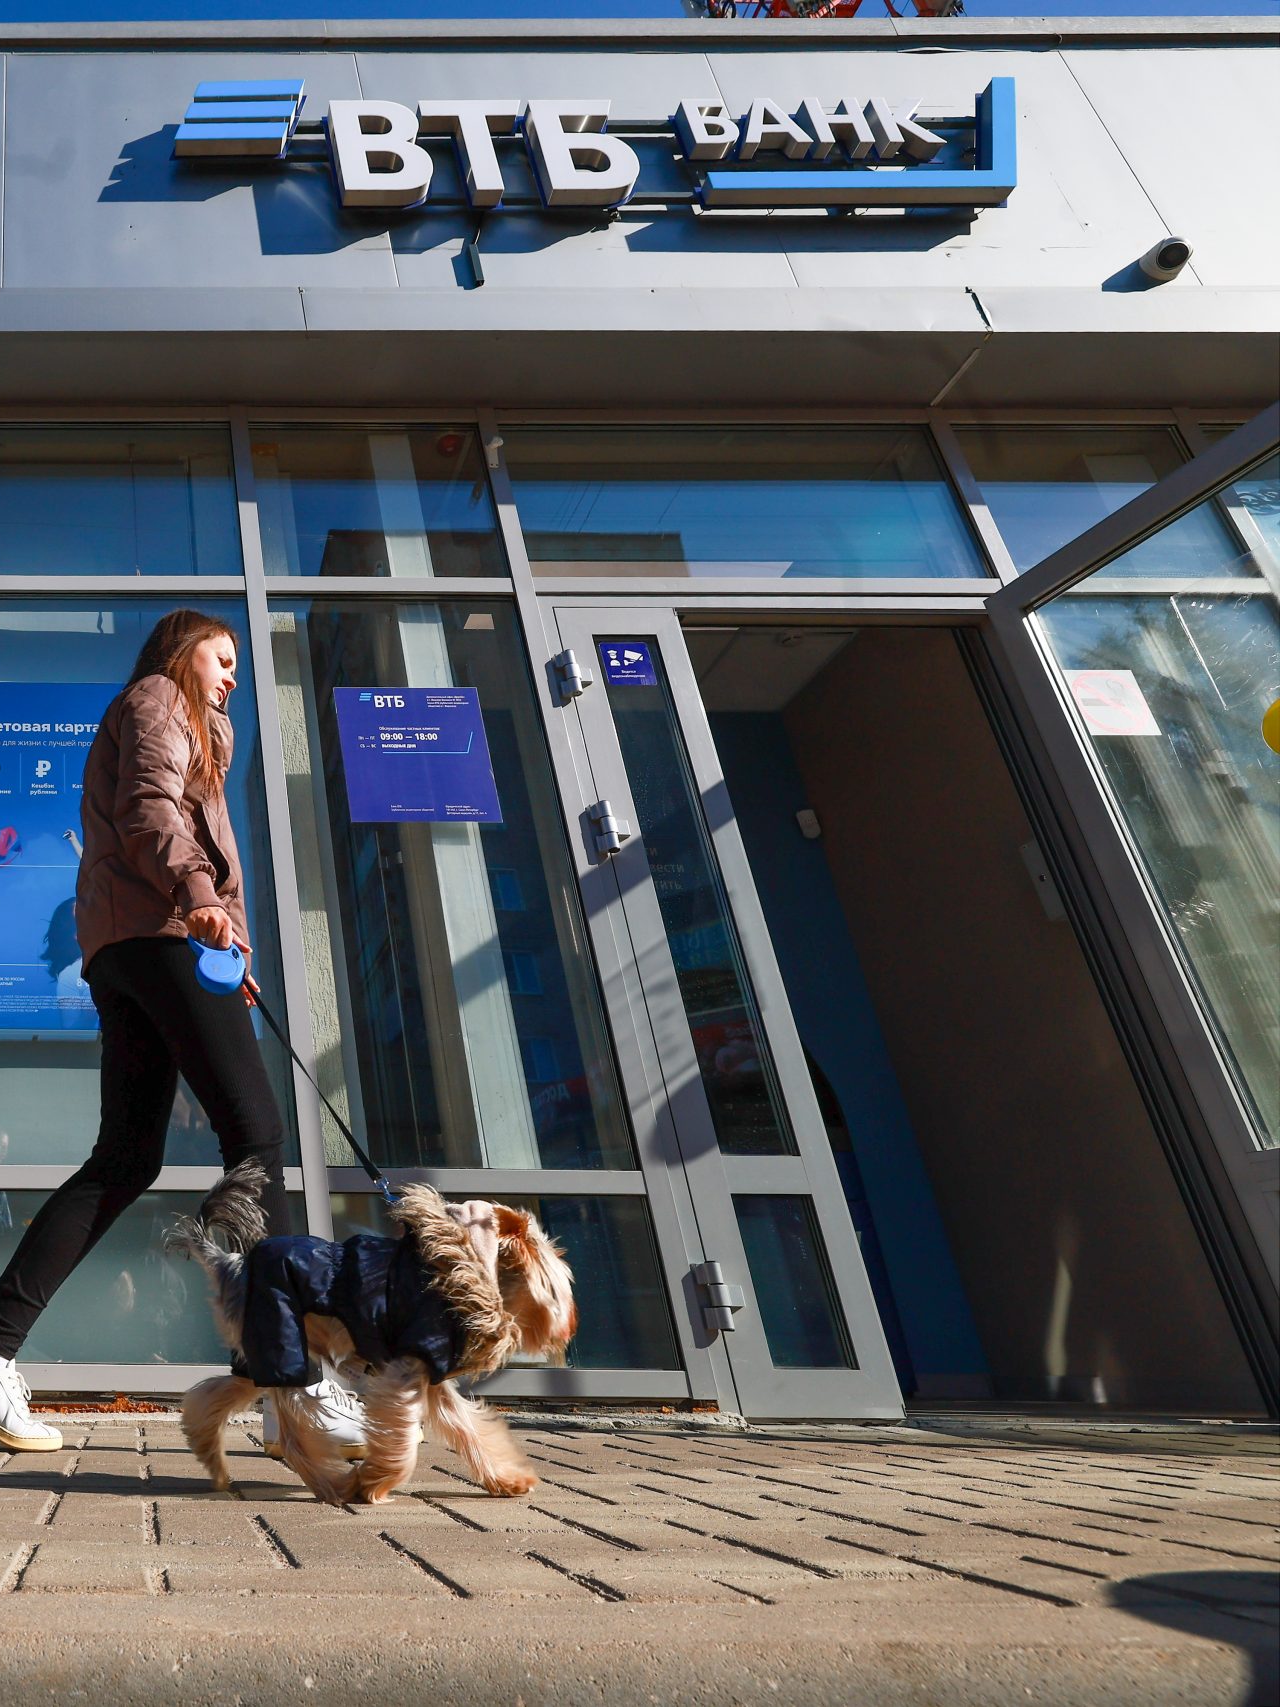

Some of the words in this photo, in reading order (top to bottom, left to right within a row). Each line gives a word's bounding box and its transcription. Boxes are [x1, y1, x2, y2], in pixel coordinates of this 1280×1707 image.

[676, 97, 945, 162] БАНК
[328, 98, 640, 210] ВТБ
[373, 695, 405, 708] ВТБ
[48, 739, 76, 749] лучшей
[78, 741, 94, 749] про
